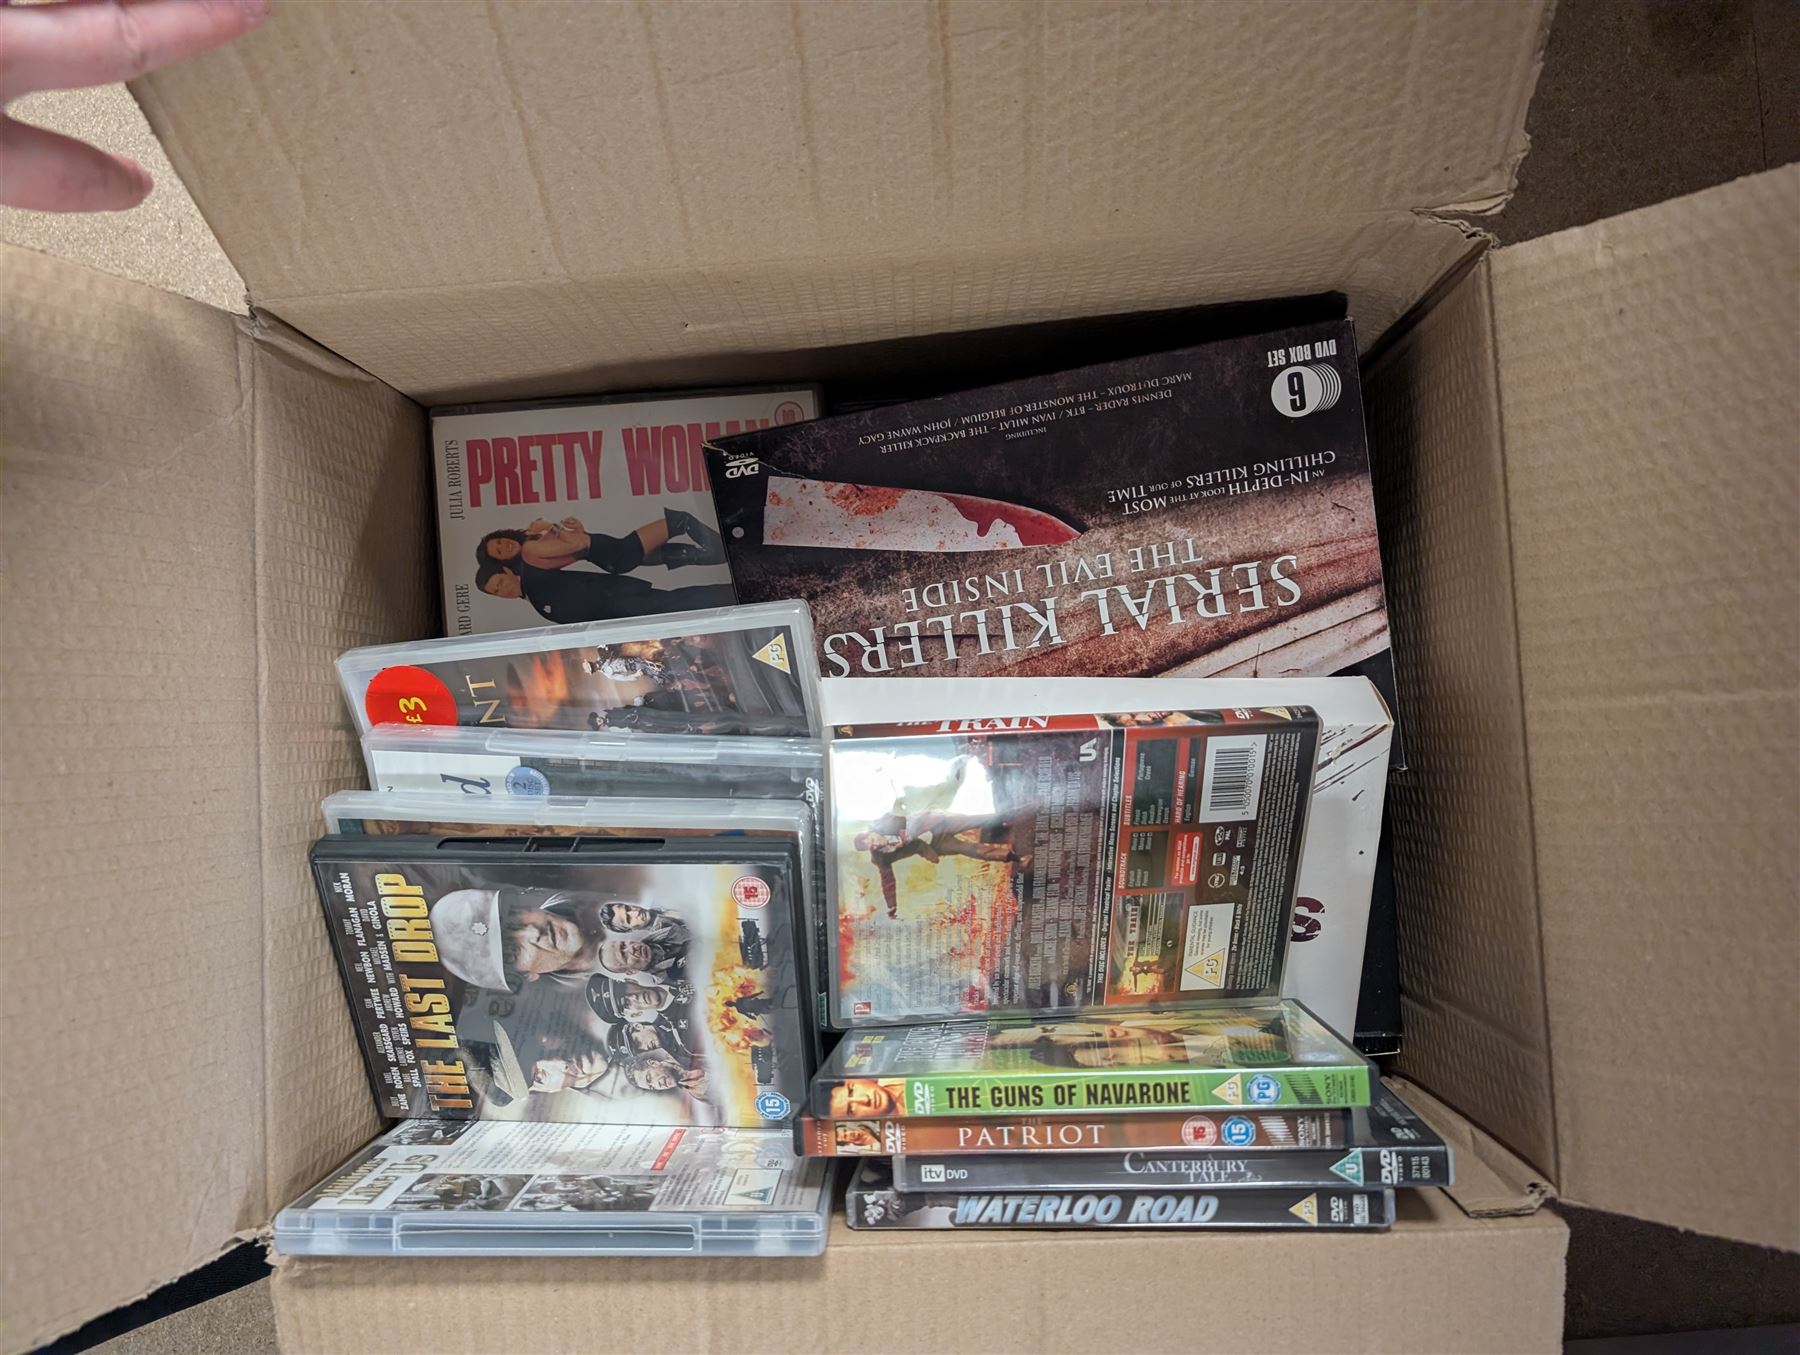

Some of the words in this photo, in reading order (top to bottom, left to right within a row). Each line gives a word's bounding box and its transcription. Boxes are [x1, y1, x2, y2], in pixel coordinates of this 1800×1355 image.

[1289, 344, 1312, 363] BOX
[1314, 338, 1336, 358] DVD
[1268, 349, 1286, 368] SET
[1108, 378, 1160, 396] DUTROUX
[1162, 372, 1192, 386] MARC
[1024, 395, 1074, 412] MONSTER
[1078, 392, 1098, 402] THE
[1096, 396, 1129, 412] RADER
[1133, 389, 1172, 406] DENNIS
[961, 408, 1006, 423] BELGIUM
[1009, 406, 1022, 416] OF
[1032, 412, 1056, 424] IVAN
[1066, 406, 1086, 418] BTK
[886, 426, 922, 440] WAYNE
[924, 418, 952, 432] JOHN
[970, 426, 989, 438] THE
[1000, 418, 1029, 432] MILAT
[1005, 426, 1046, 441] INCLUDING
[858, 434, 884, 446] GACY
[880, 442, 914, 454] KILLER
[915, 430, 966, 448] BACKPACK
[445, 439, 462, 488] ROBERTS
[466, 430, 604, 508] PRETTY
[726, 463, 759, 479] DVD
[1253, 450, 1336, 476] CHILLING
[1186, 466, 1248, 488] KILLERS
[1228, 470, 1310, 496] IN-DEPTH
[1312, 469, 1326, 478] AN
[1107, 485, 1147, 503] TIME
[1149, 482, 1169, 492] OUR
[1170, 480, 1183, 489] OF
[1201, 488, 1226, 498] LOOK
[449, 488, 465, 520] JULIA
[1170, 494, 1186, 503] THE
[1188, 492, 1200, 500] AT
[1122, 496, 1167, 516] MOST
[1130, 537, 1202, 574] THE
[1036, 552, 1115, 589] EVIL
[456, 583, 470, 613] GERE
[902, 568, 1025, 613] INSIDE
[1080, 554, 1302, 638] SERIAL
[823, 597, 1066, 678] KILLERS
[768, 643, 785, 662] PG
[1112, 757, 1121, 784] Selections
[1110, 783, 1120, 802] Chapter
[1176, 770, 1186, 796] HEARING
[1110, 802, 1118, 812] and
[1123, 794, 1132, 826] SUBTITLES
[1176, 797, 1183, 806] OF
[1108, 813, 1117, 832] Screens
[1174, 807, 1183, 824] HARD
[1118, 852, 1128, 889] SOUNDTRACK
[333, 882, 343, 892] NICK
[339, 872, 355, 902] MORAN
[1102, 891, 1110, 914] Theatrical
[367, 900, 382, 930] GINOLA
[375, 874, 439, 962] DROP
[1101, 914, 1110, 932] Original
[343, 918, 354, 935] TOMMY
[348, 907, 366, 946] FLANAGAN
[370, 947, 381, 965] MICHAEL
[377, 940, 392, 971] MADSEN
[360, 951, 376, 983] NEWBON
[1206, 958, 1219, 976] PG
[386, 972, 396, 984] WITH
[1096, 972, 1104, 984] THIS
[370, 988, 386, 1019] PERTWEE
[389, 987, 405, 1018] HOWARD
[399, 974, 459, 1048] LAST
[379, 1024, 396, 1062] SKARSGARD
[398, 1023, 411, 1045] SPEIRS
[405, 1050, 416, 1064] FOX
[390, 1066, 404, 1089] RODEN
[410, 1068, 422, 1088] SPALL
[420, 1060, 474, 1112] THE
[914, 1081, 924, 1114] DVD
[946, 1087, 982, 1108] THE
[991, 1085, 1043, 1107] GUNS
[1054, 1084, 1077, 1105] OF
[1086, 1082, 1190, 1104] NAVARONE
[1257, 1081, 1271, 1100] PG
[398, 1093, 409, 1111] ZANE
[765, 1098, 781, 1112] 15
[885, 1121, 895, 1153] DVD
[958, 1125, 1105, 1146] PATRIOT
[1192, 1126, 1207, 1140] 15
[1232, 1123, 1246, 1141] 15
[1123, 1151, 1248, 1174] CANTERBURY
[1345, 1163, 1358, 1174] U
[1380, 1149, 1391, 1184] DVD
[923, 1167, 944, 1180] itv
[947, 1169, 968, 1179] DVD
[1185, 1171, 1232, 1182] TALE
[954, 1195, 1122, 1224] WATERLOO
[1127, 1195, 1219, 1223] ROAD
[1330, 1197, 1339, 1222] DVD
